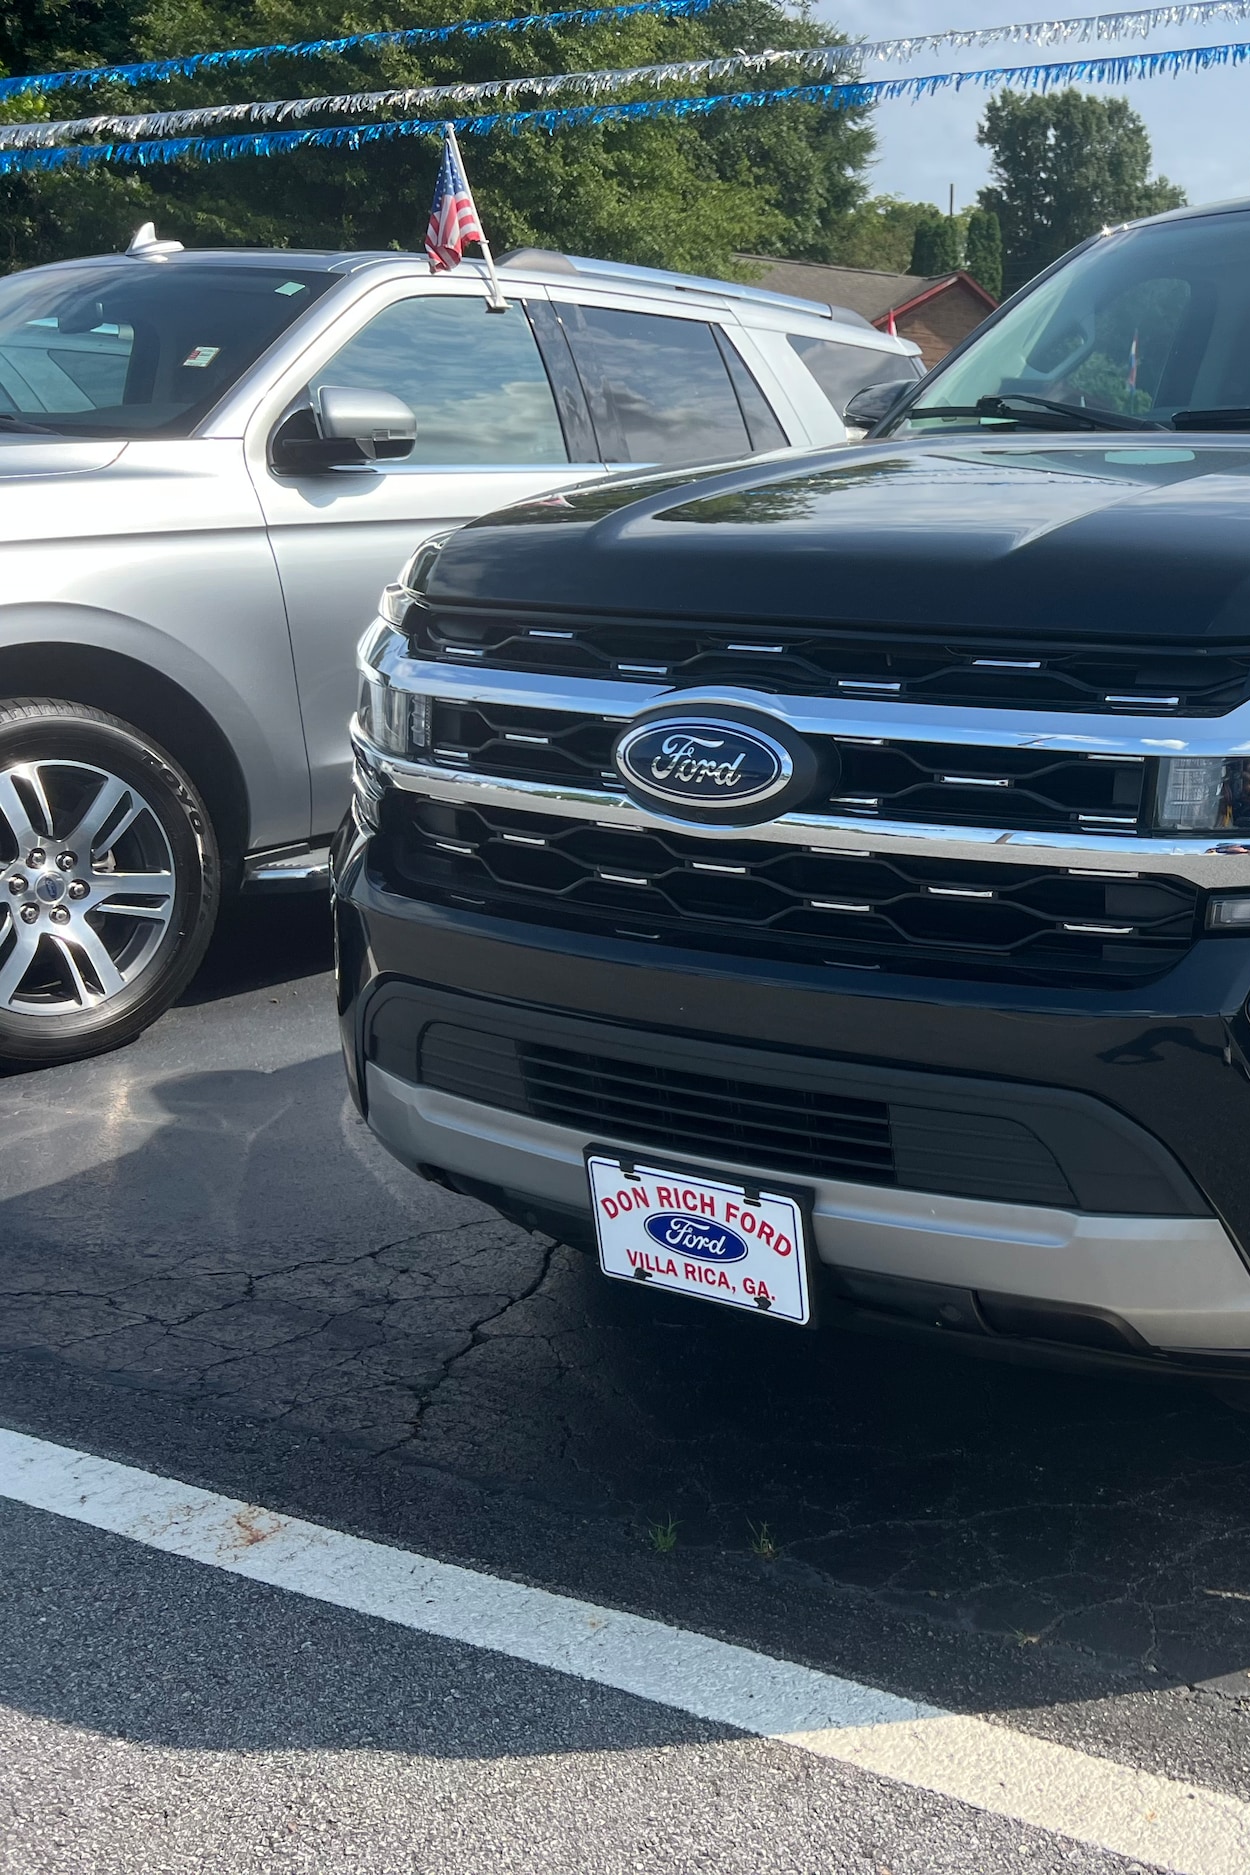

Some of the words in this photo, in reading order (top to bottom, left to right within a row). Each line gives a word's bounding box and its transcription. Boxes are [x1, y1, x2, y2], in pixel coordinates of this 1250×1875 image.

[651, 733, 747, 787] Ford
[601, 1186, 650, 1220] DON
[656, 1186, 716, 1217] RICH
[725, 1202, 792, 1257] FORD
[665, 1218, 726, 1255] Ford
[626, 1249, 678, 1277] VILLA
[684, 1262, 736, 1295] RICA,
[742, 1277, 777, 1301] GA.
